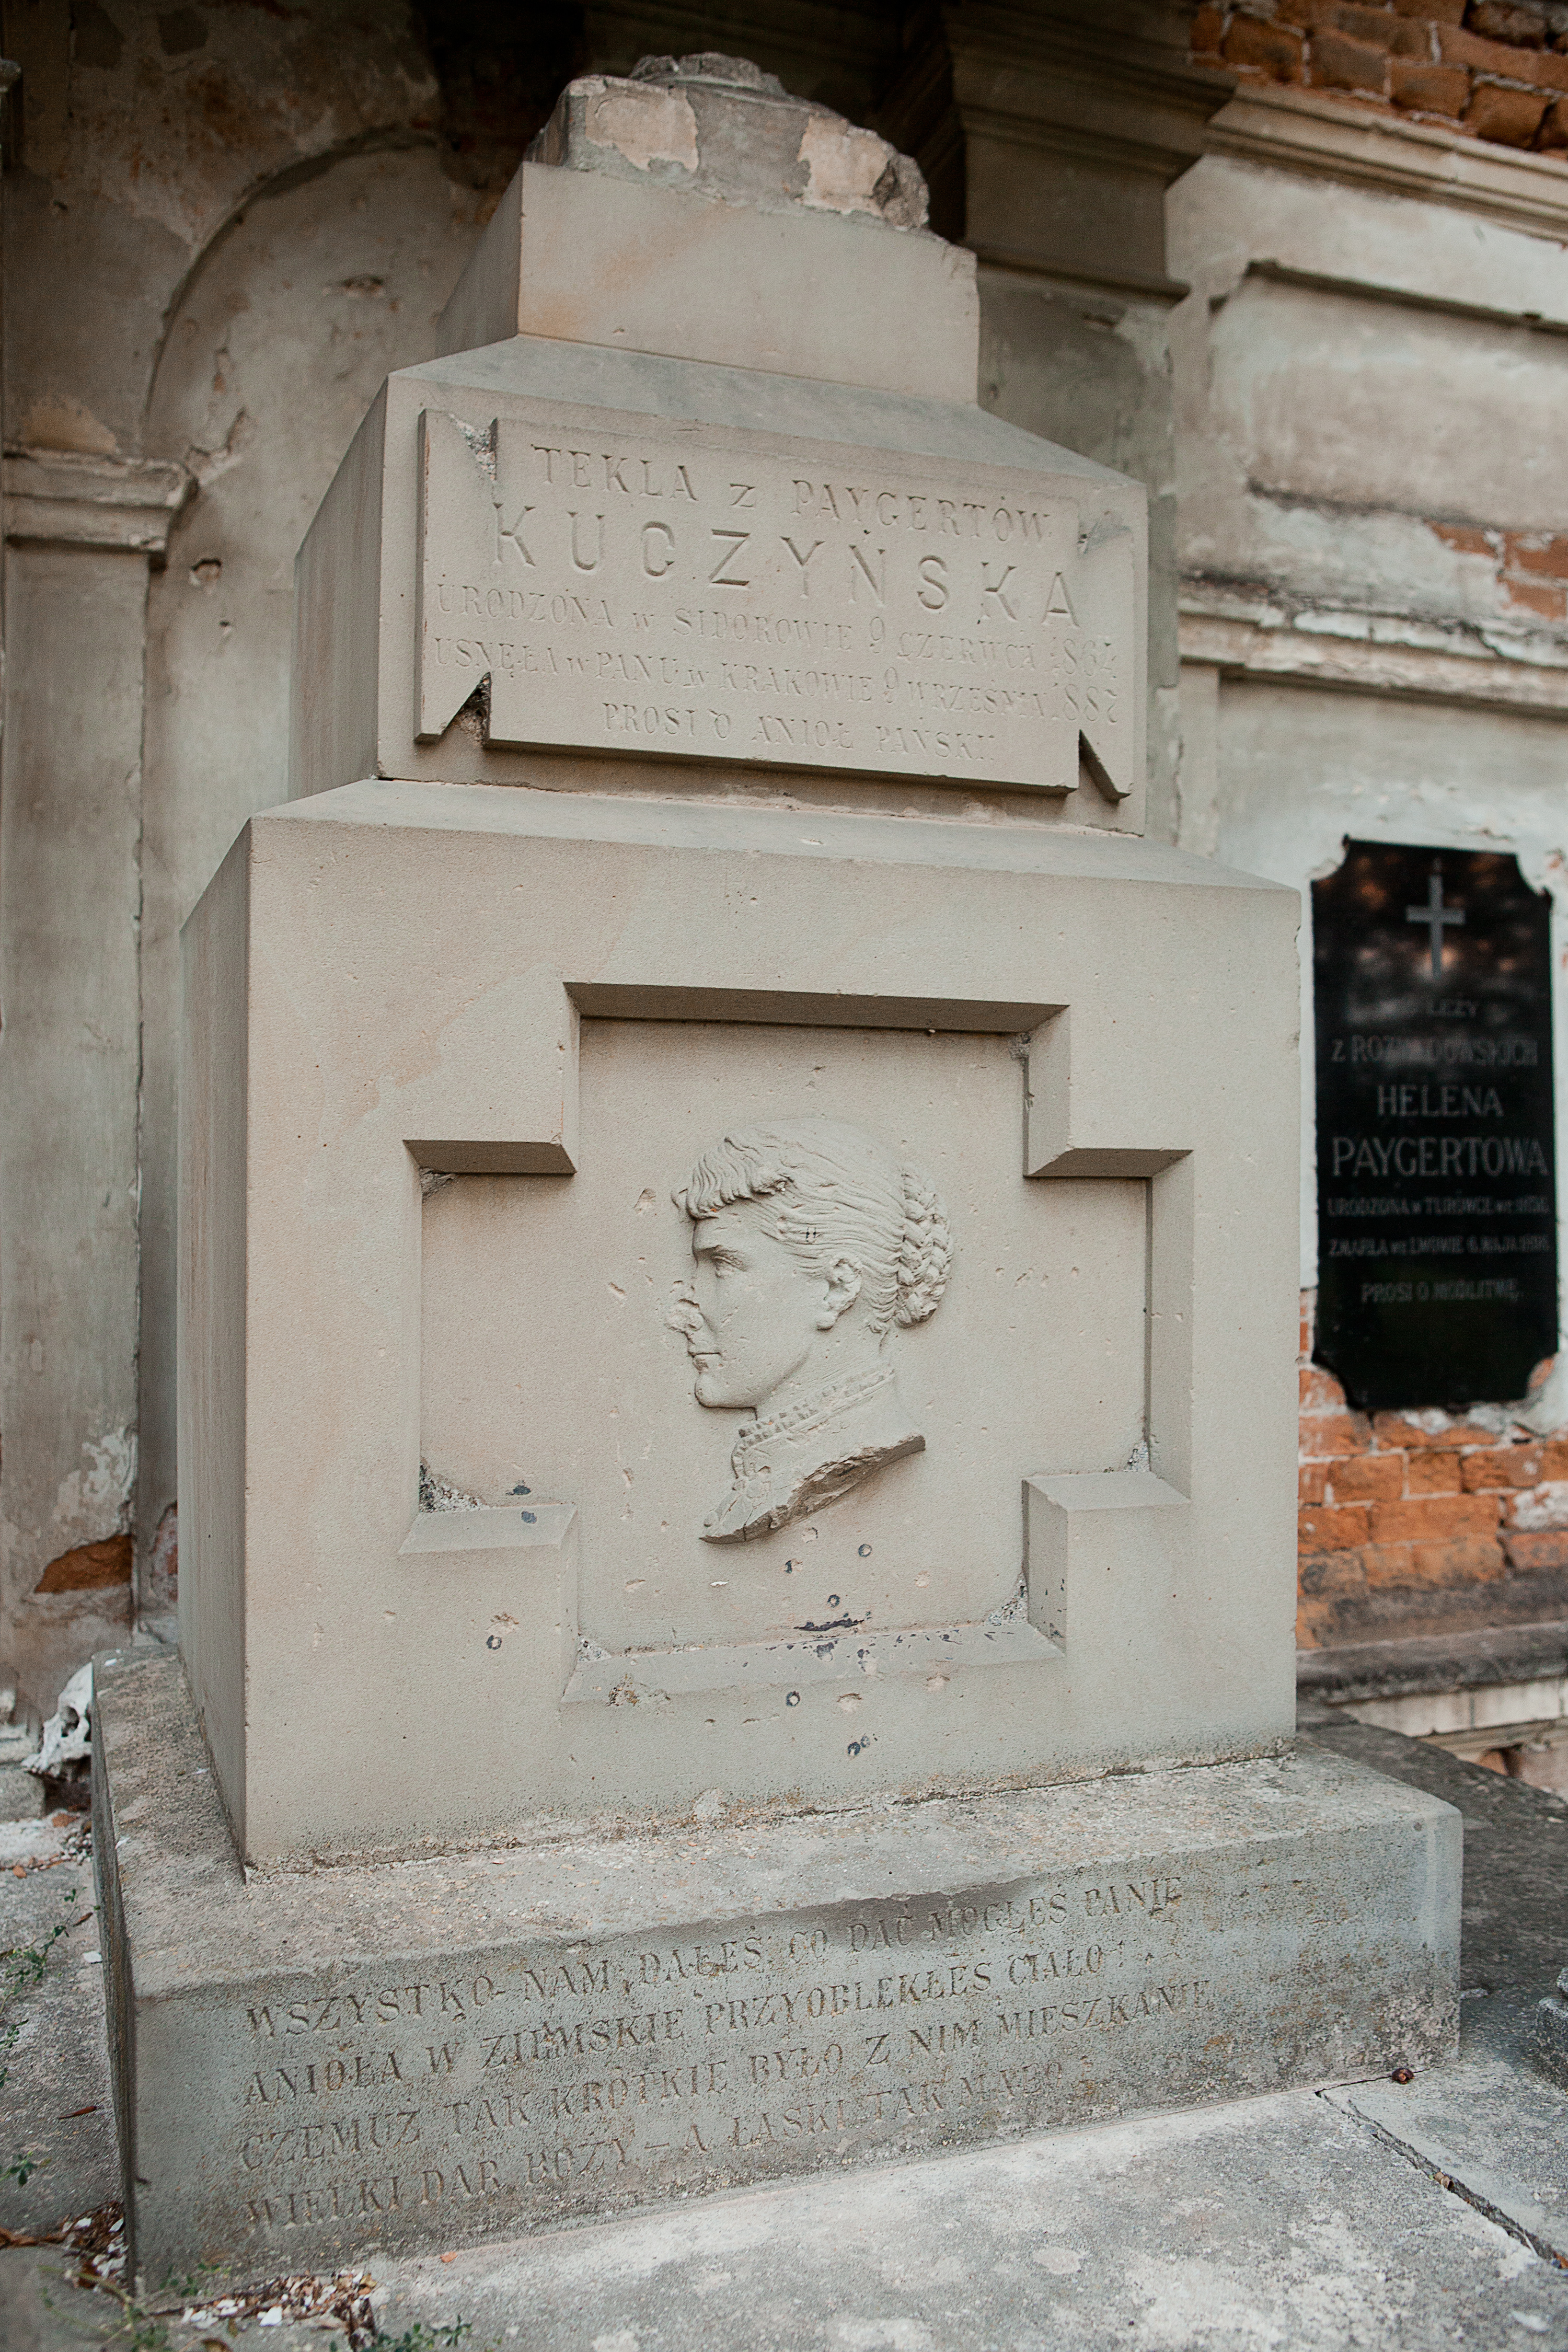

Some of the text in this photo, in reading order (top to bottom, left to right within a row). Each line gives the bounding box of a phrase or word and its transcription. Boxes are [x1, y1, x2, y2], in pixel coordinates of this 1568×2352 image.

[530, 442, 698, 502] TEKLA
[790, 479, 1046, 545] PAYGERTÓW
[437, 581, 614, 628] URODZONA
[673, 606, 852, 651] SIDOROWIE
[896, 631, 1036, 671] CZERWCA
[595, 651, 677, 685] PANU
[720, 661, 873, 703] KRAKOWIE
[601, 701, 696, 736] PROSI
[750, 714, 854, 750] ANIOŁ
[1376, 1083, 1504, 1118] HELENA
[1331, 1136, 1550, 1177] PAYGERTOWA
[245, 2050, 403, 2108] ANIOŁA
[480, 2009, 684, 2071] ZIEMSKIE
[444, 2092, 532, 2136] TAK
[748, 2043, 844, 2085] BYŁO
[864, 2033, 890, 2069] Z
[907, 2019, 981, 2062] NIM
[246, 2175, 399, 2230] WIELKI
[419, 2159, 500, 2205] DAR
[728, 2098, 848, 2147] ŁASKI
[867, 2084, 945, 2122] TAK
